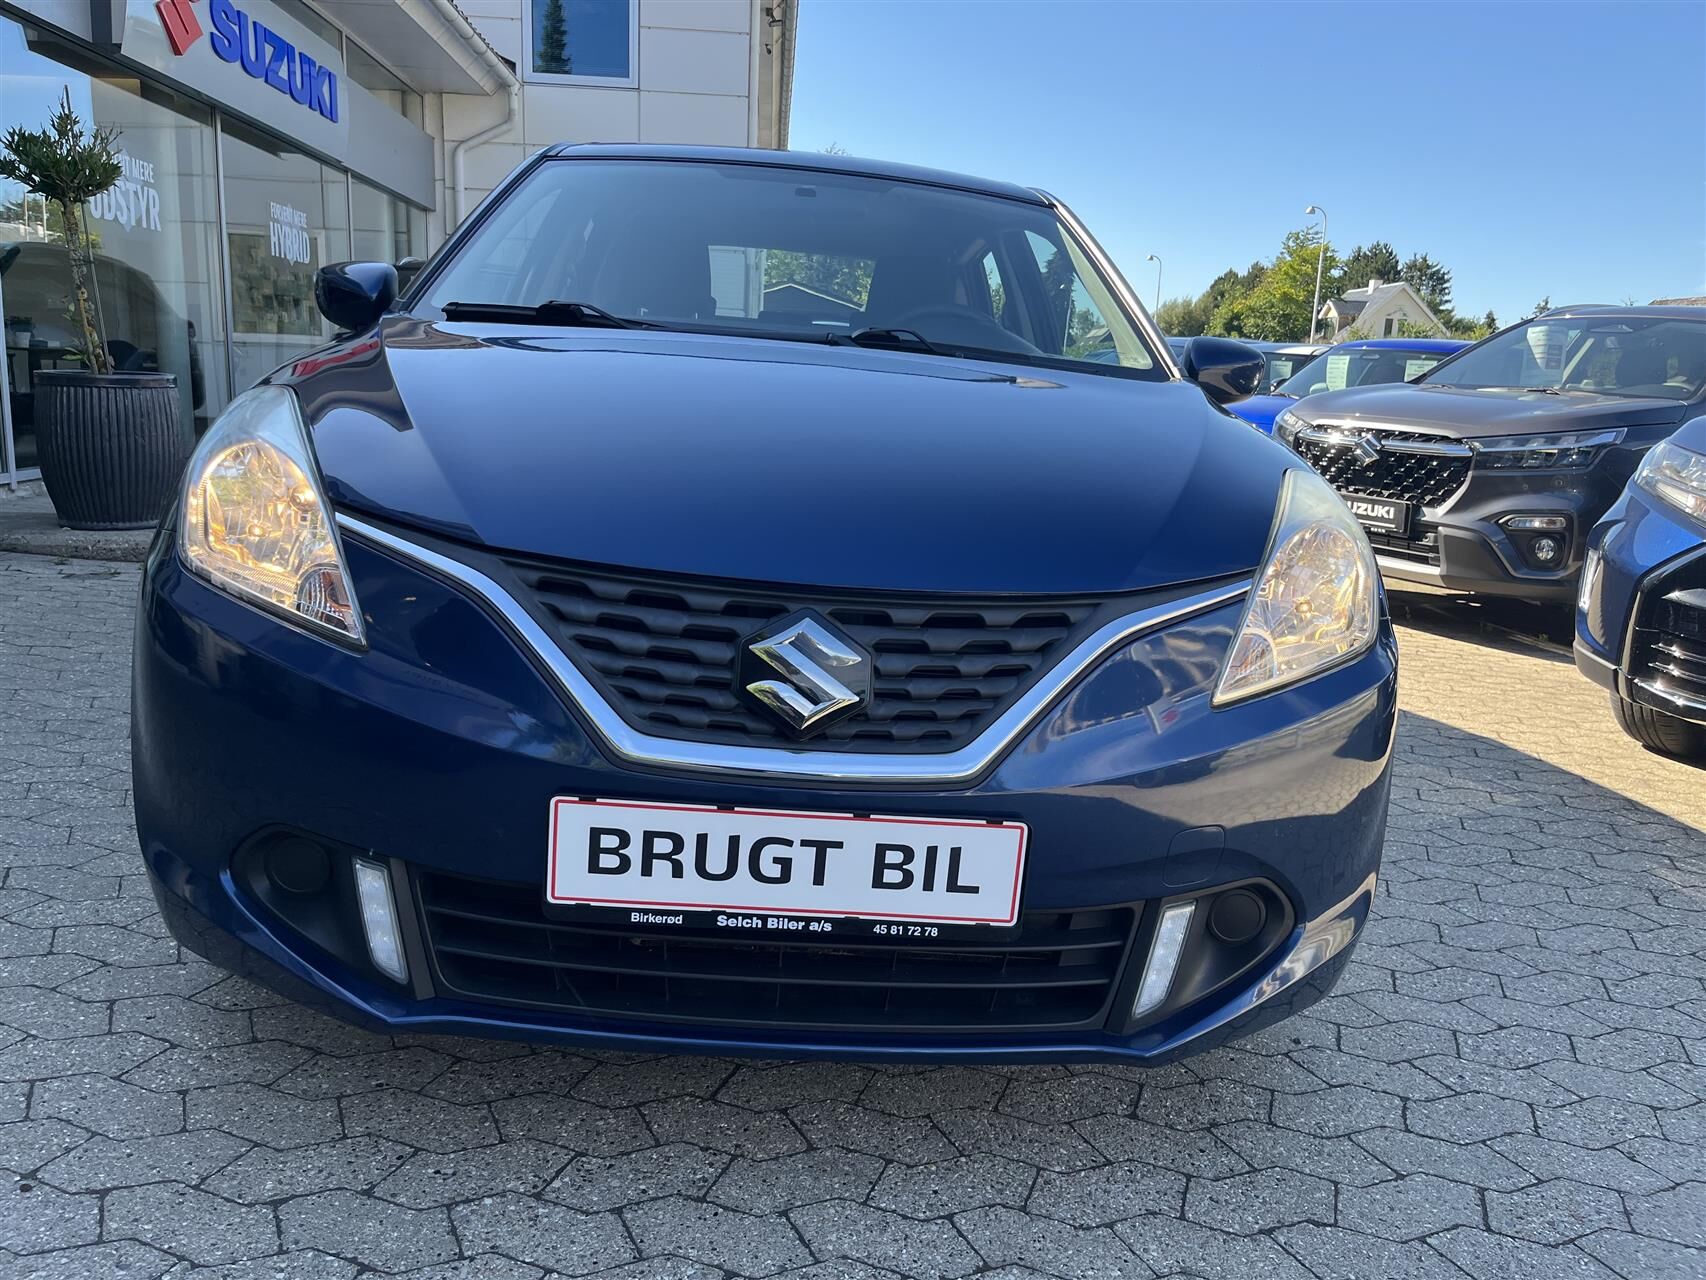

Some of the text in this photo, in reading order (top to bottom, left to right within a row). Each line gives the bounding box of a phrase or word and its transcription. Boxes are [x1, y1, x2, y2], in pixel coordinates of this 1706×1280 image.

[209, 0, 338, 123] SUZUKI
[131, 157, 154, 183] MERE
[270, 221, 310, 264] HYBRID
[1347, 500, 1395, 519] UZUKI
[587, 826, 980, 894] BRUGT BIL
[631, 912, 683, 925] Birkerød
[716, 914, 833, 932] Selch Biler a/s
[873, 924, 938, 937] 45 81 72 78
